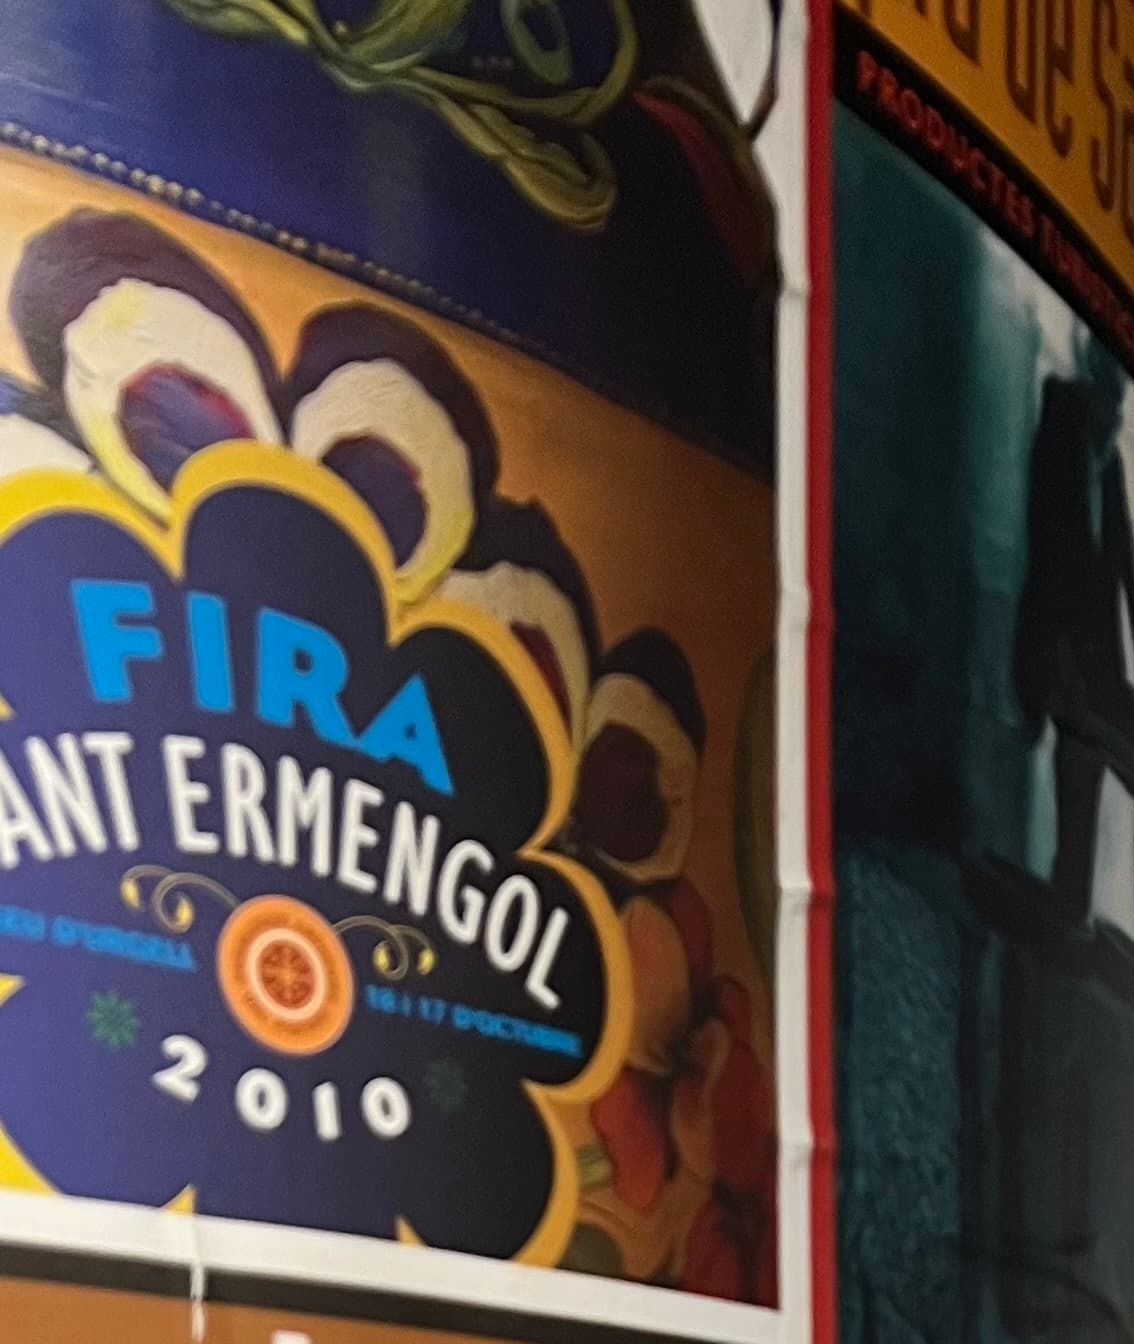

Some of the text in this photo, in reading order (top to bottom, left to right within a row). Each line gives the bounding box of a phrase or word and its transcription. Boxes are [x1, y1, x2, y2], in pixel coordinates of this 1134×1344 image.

[857, 51, 1035, 238] PRODUCTES
[70, 577, 454, 795] FIRA
[0, 731, 574, 1010] ANT ERMENGOL
[152, 1033, 412, 1142] 2010
